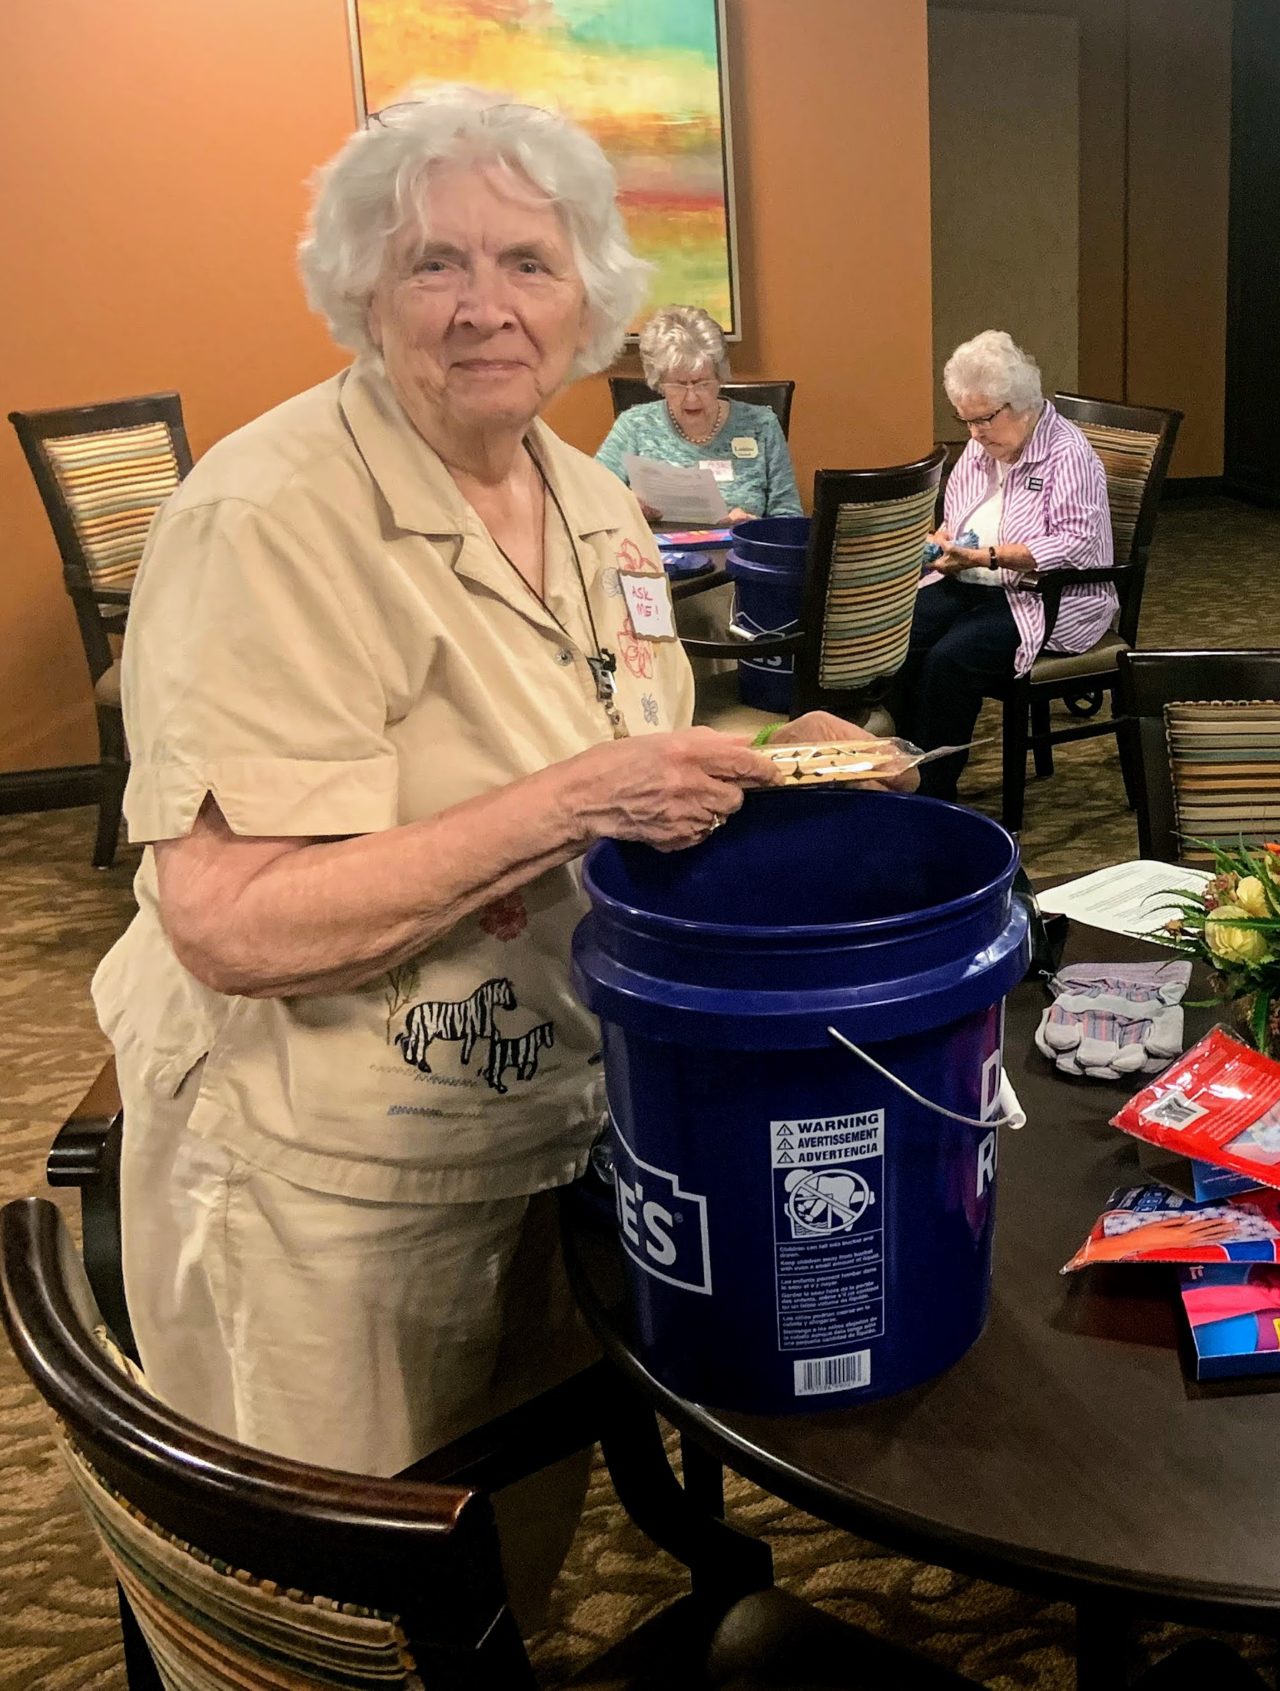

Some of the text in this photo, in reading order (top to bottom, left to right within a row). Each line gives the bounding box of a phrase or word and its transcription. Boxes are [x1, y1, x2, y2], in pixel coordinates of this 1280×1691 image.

[797, 1113, 879, 1134] WARNING
[797, 1128, 879, 1149] AVERTISSEMENT
[797, 1142, 878, 1163] ADVERTENCIA
